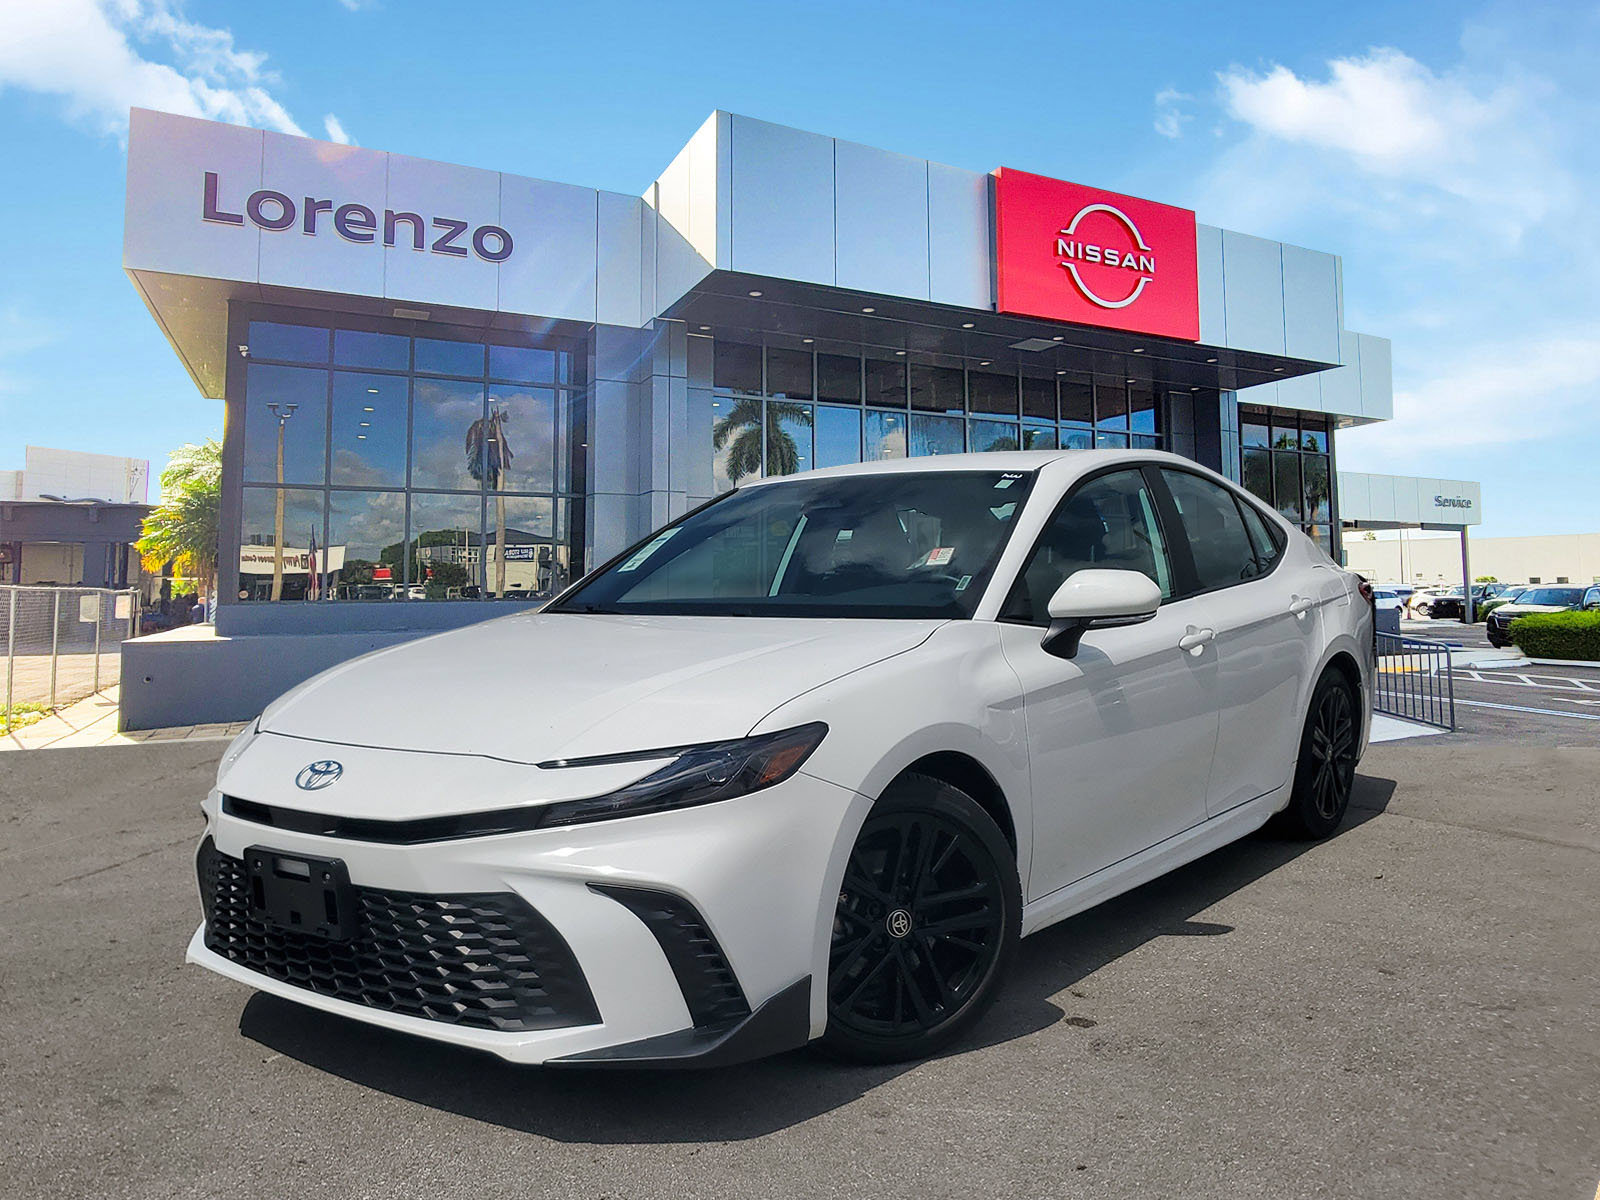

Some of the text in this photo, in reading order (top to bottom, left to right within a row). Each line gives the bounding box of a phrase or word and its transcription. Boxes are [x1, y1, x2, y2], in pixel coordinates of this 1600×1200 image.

[203, 171, 514, 262] Lorenzo
[1058, 238, 1155, 273] NISSAN
[1434, 495, 1472, 508] Service
